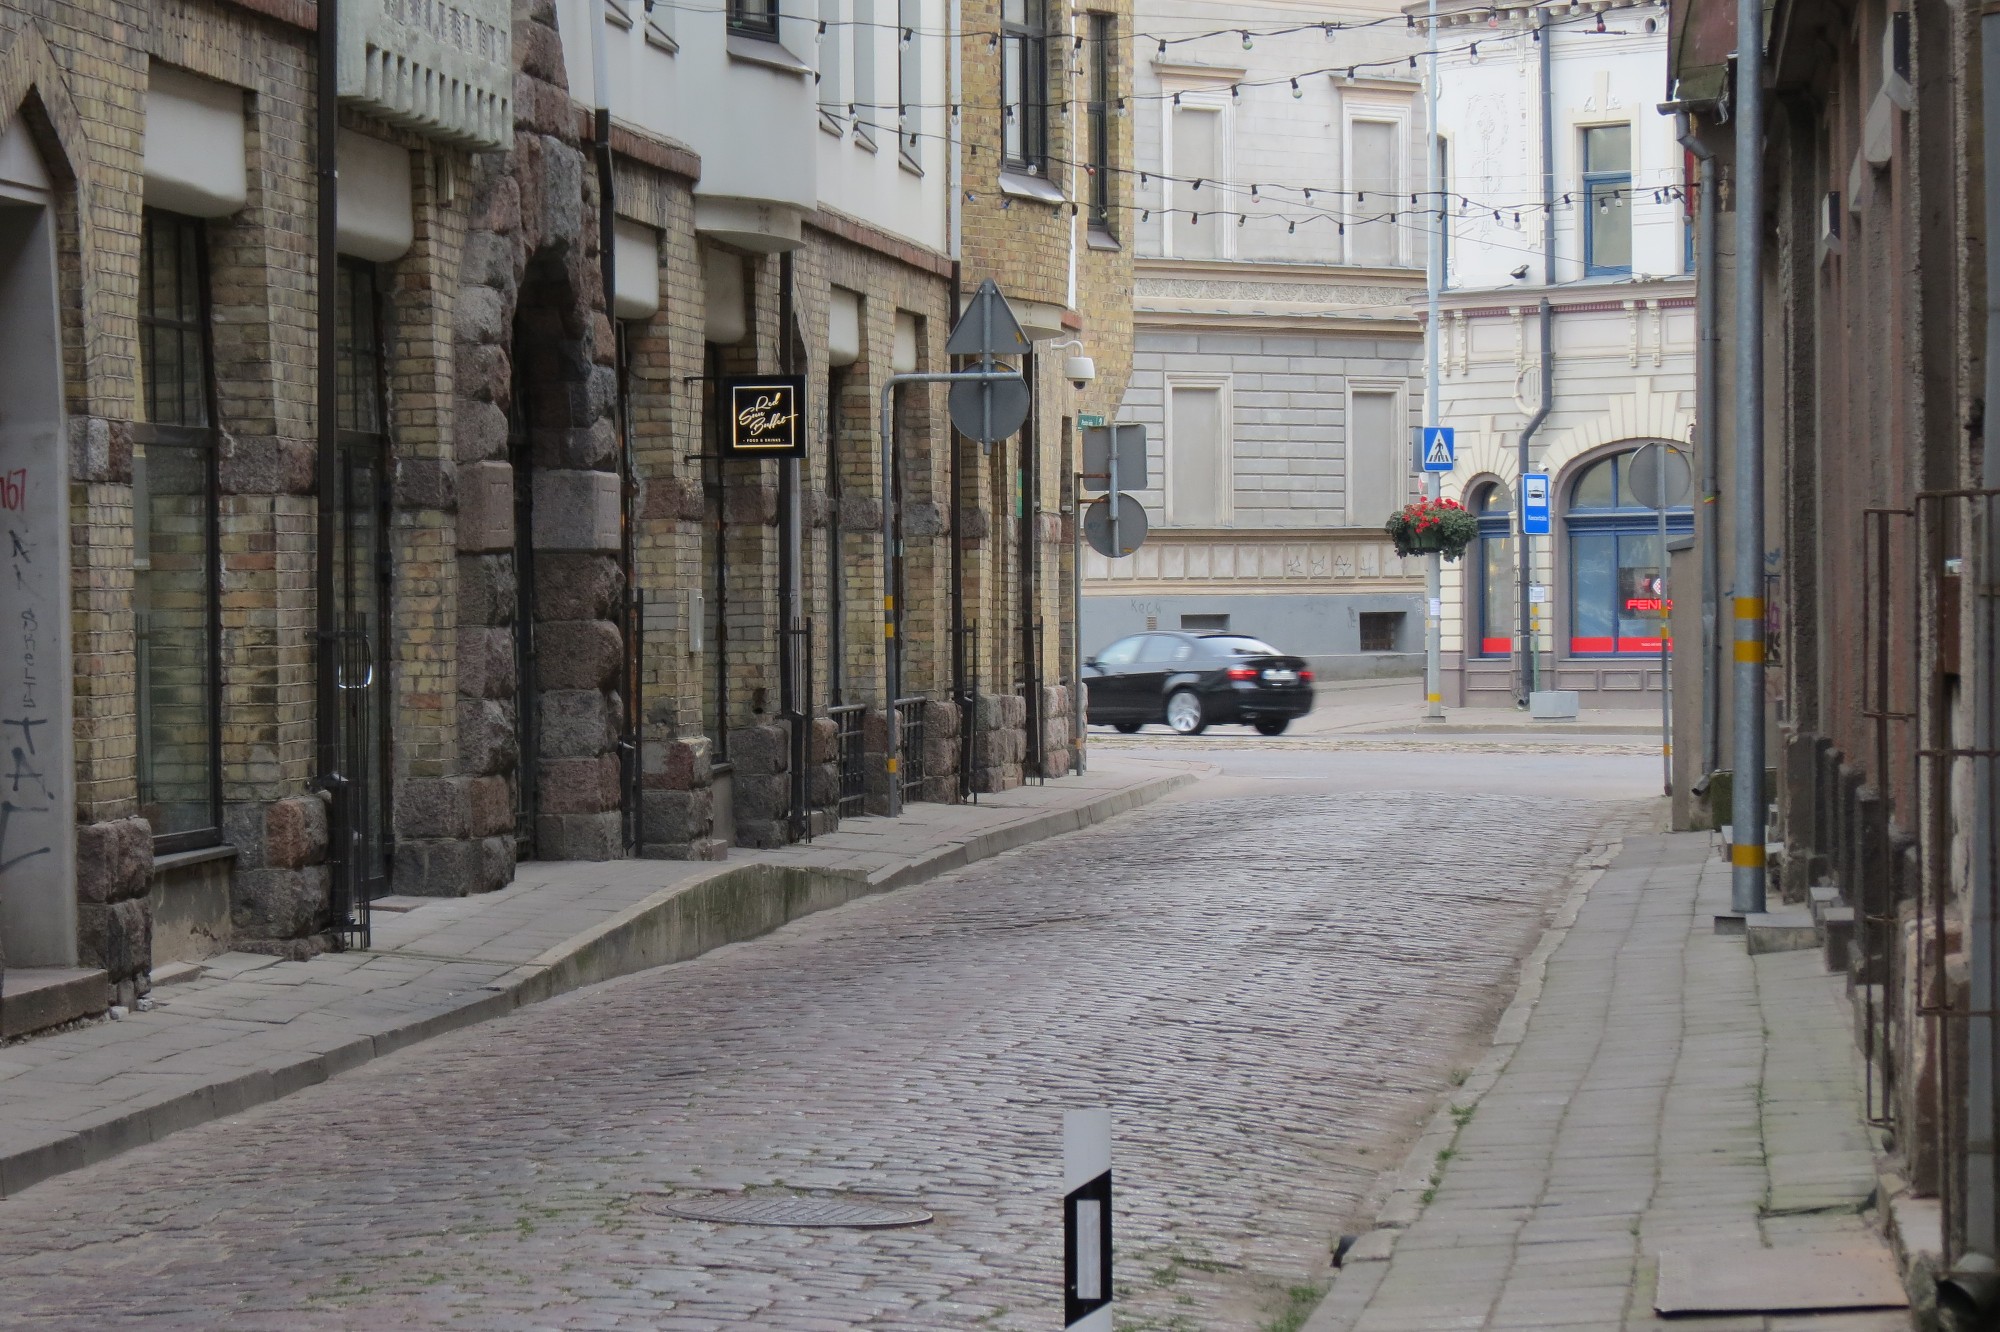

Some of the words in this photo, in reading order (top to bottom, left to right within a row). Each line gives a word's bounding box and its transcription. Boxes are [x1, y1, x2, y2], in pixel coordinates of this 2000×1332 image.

[755, 392, 781, 412] Red
[749, 412, 799, 436] Buffet
[1626, 599, 1673, 610] FENI
